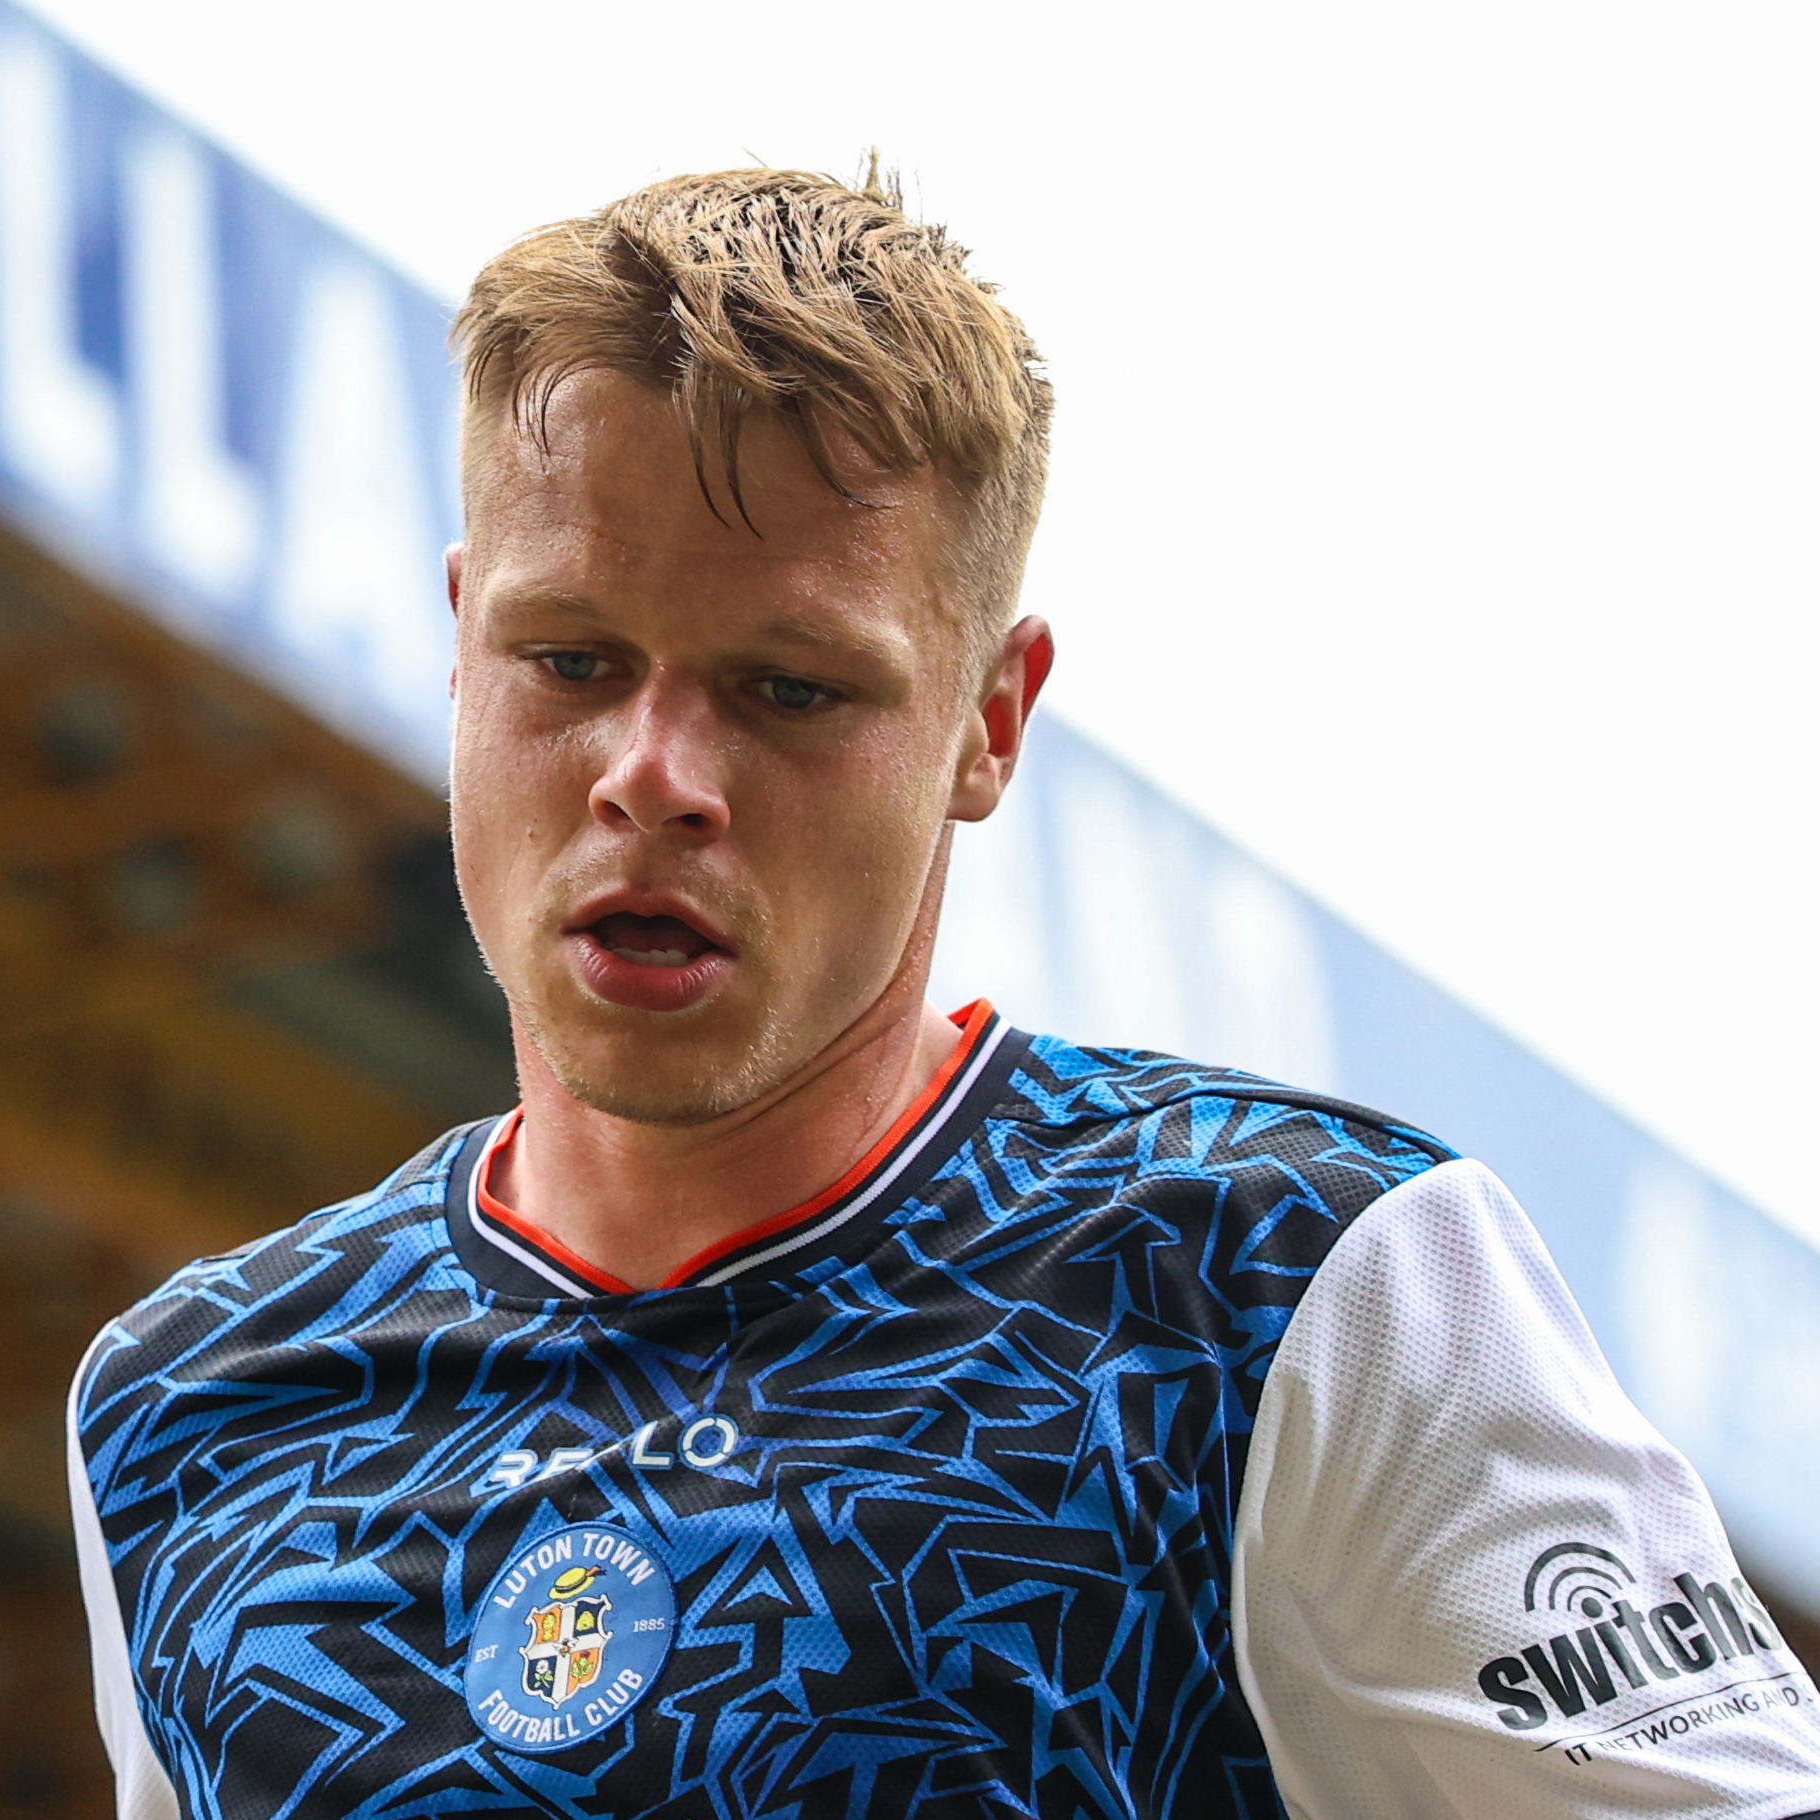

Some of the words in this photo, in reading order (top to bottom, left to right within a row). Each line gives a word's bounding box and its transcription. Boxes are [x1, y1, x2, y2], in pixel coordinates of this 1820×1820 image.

[493, 1534, 572, 1609] LUTON
[583, 1532, 656, 1586] TOWN
[475, 1644, 499, 1663] EST
[631, 1617, 666, 1633] 1885
[478, 1689, 581, 1744] FOOTBALL
[584, 1668, 644, 1727] CLUB
[1564, 1740, 1593, 1766] IT
[1595, 1692, 1761, 1754] NETWORKING
[1762, 1686, 1800, 1709] AND
